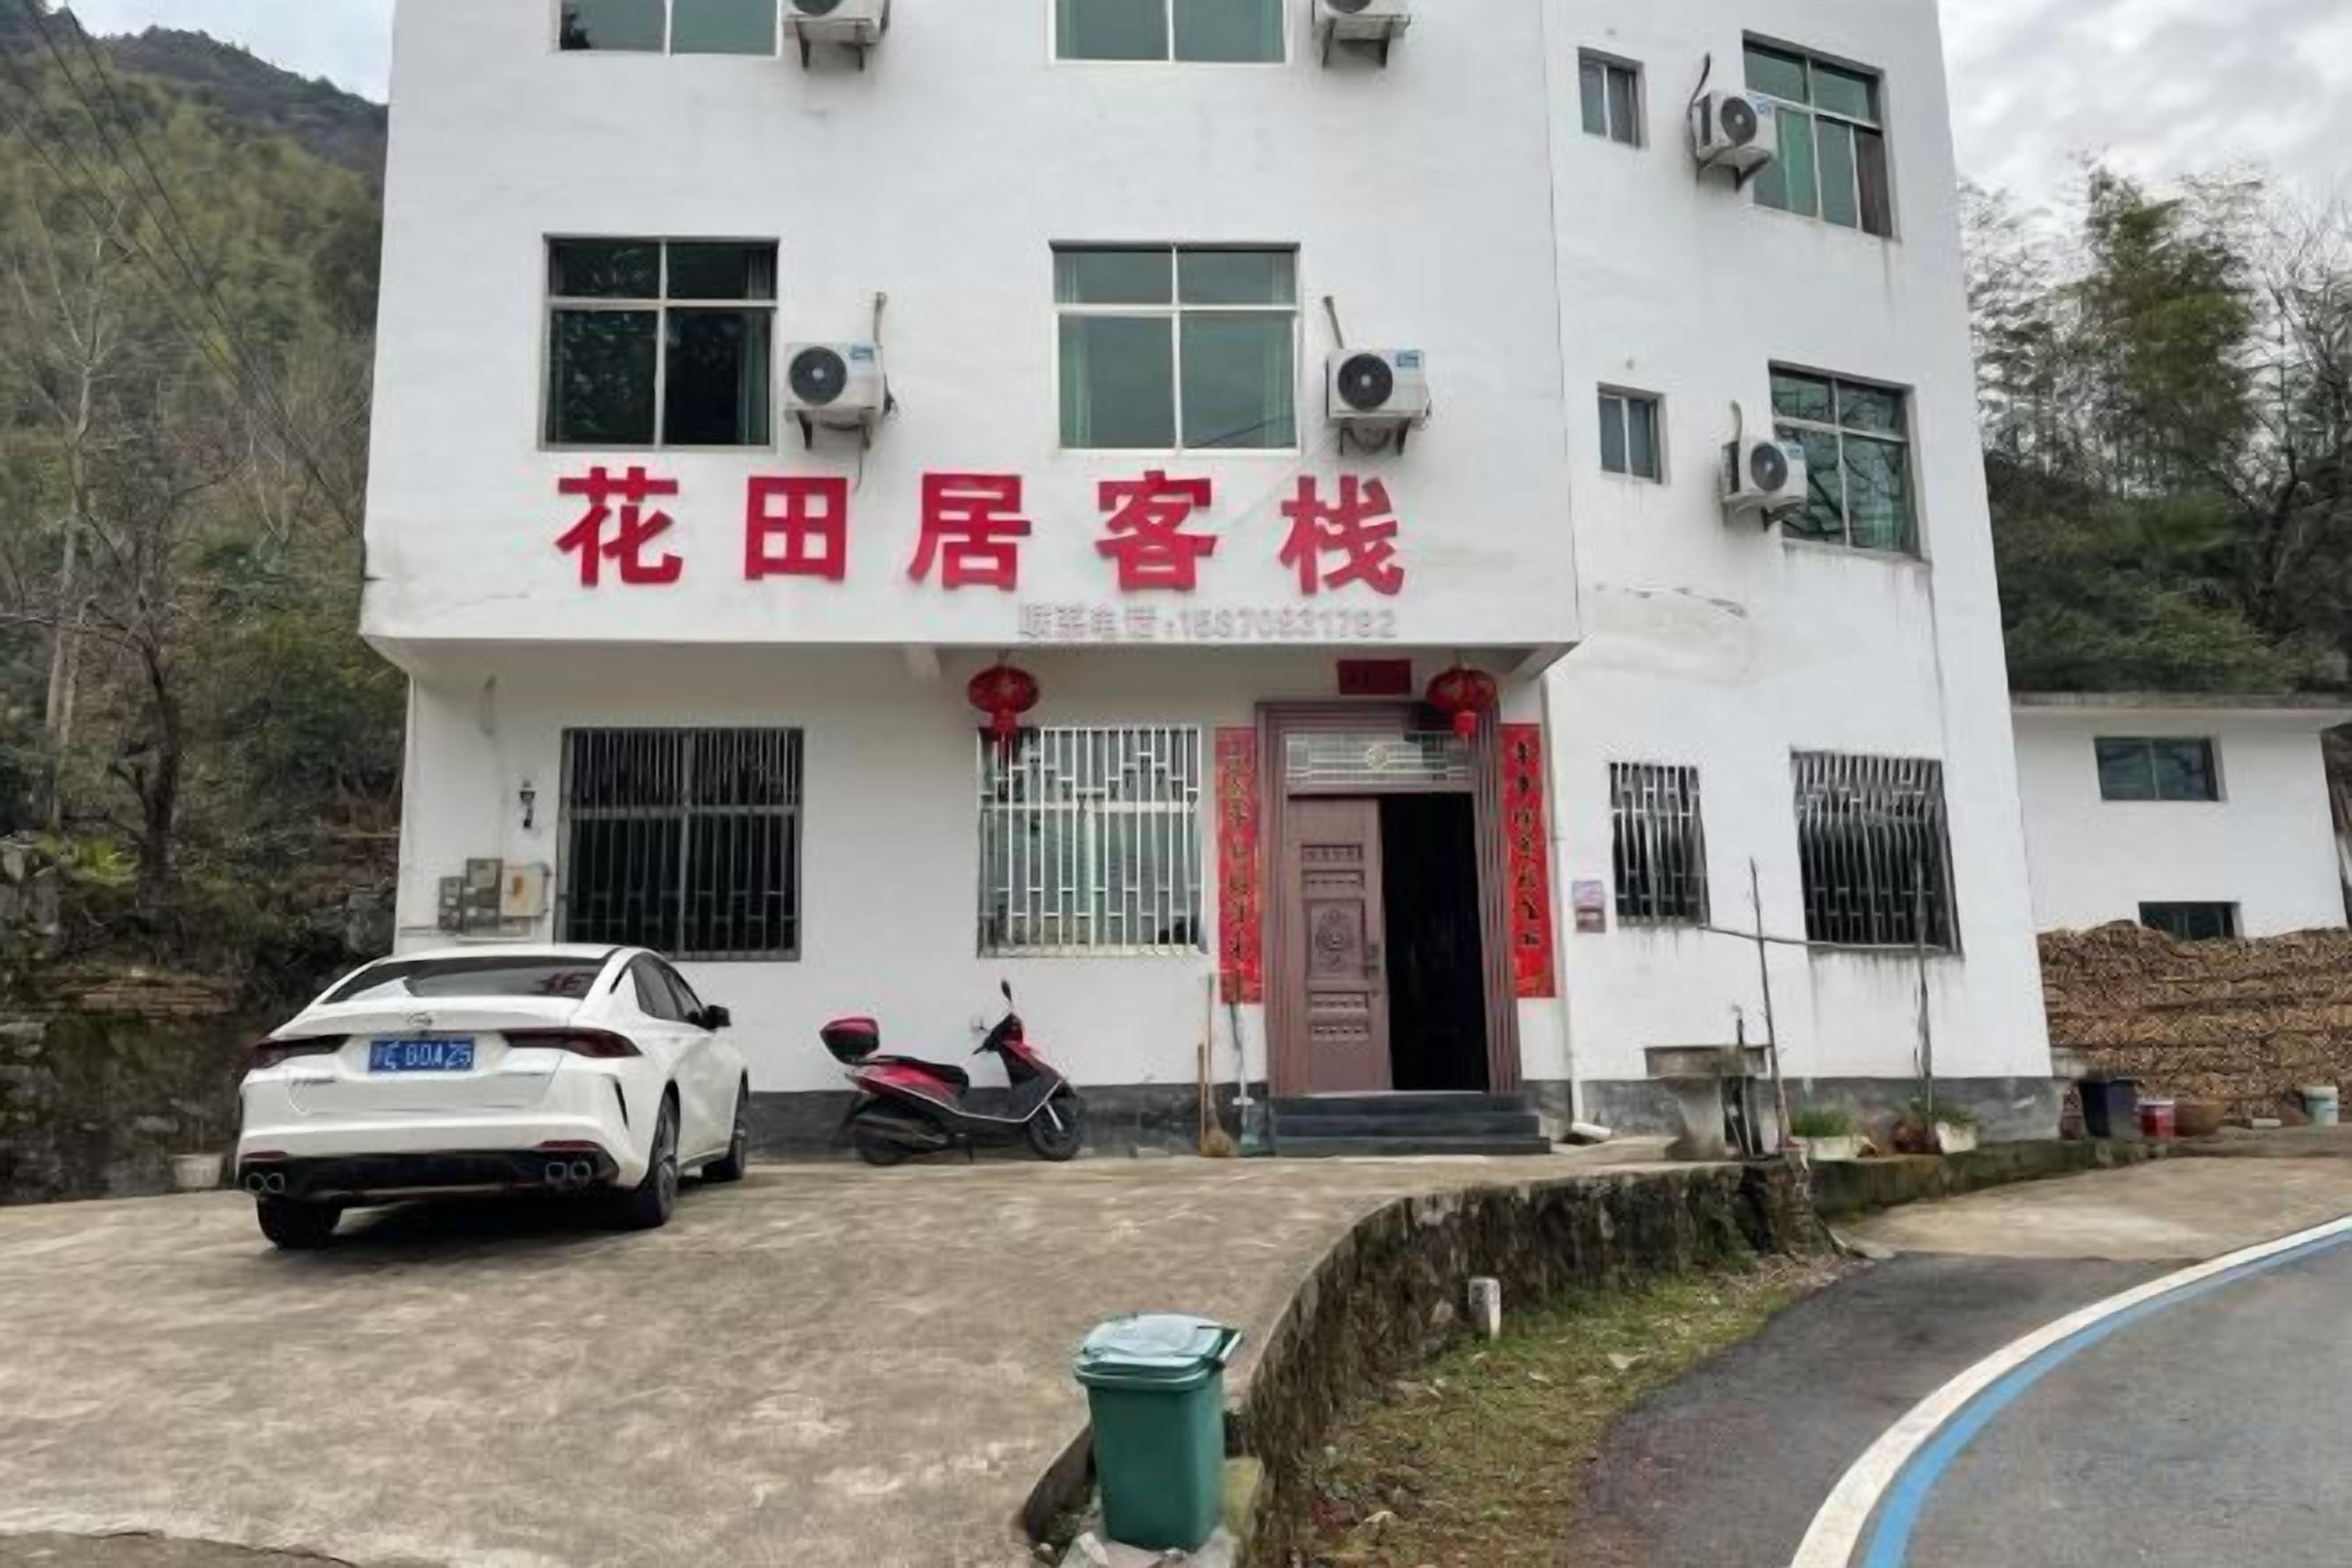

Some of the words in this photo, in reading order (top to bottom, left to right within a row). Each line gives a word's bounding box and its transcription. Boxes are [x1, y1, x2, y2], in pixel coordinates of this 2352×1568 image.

[554, 466, 1405, 595] 花田居客栈
